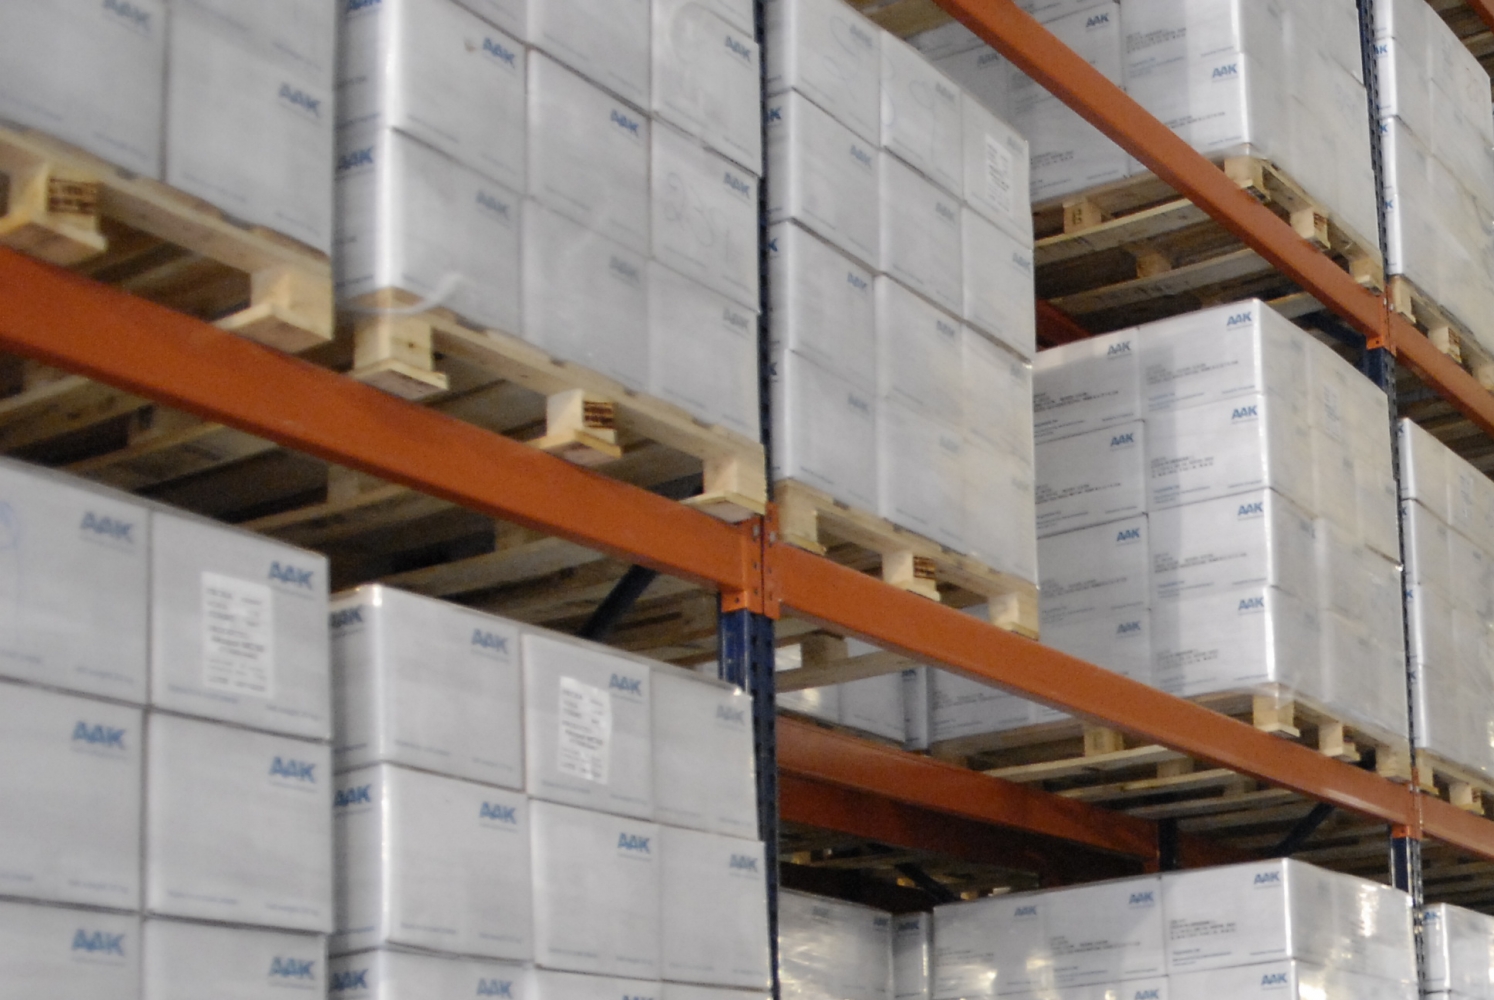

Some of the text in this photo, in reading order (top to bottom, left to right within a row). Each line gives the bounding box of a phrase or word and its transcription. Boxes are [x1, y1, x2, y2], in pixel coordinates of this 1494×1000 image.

[1085, 12, 1109, 28] AAK
[1212, 63, 1238, 79] AAK
[1226, 311, 1252, 328] AAK
[1107, 340, 1131, 356] AAK
[1231, 404, 1258, 421] AAK
[1110, 432, 1135, 448] AAK
[1237, 501, 1263, 517] AAK
[1116, 527, 1140, 543] AAK
[1238, 596, 1264, 612] AAK
[1116, 620, 1141, 636] AAK
[471, 628, 509, 656] AAK
[609, 672, 642, 697] AAK
[480, 801, 518, 826] AAK
[617, 831, 651, 854] AAK
[730, 853, 759, 874] AAK
[1253, 871, 1281, 886] AAK
[1261, 972, 1288, 986] AAK
[476, 978, 514, 1000] AAK
